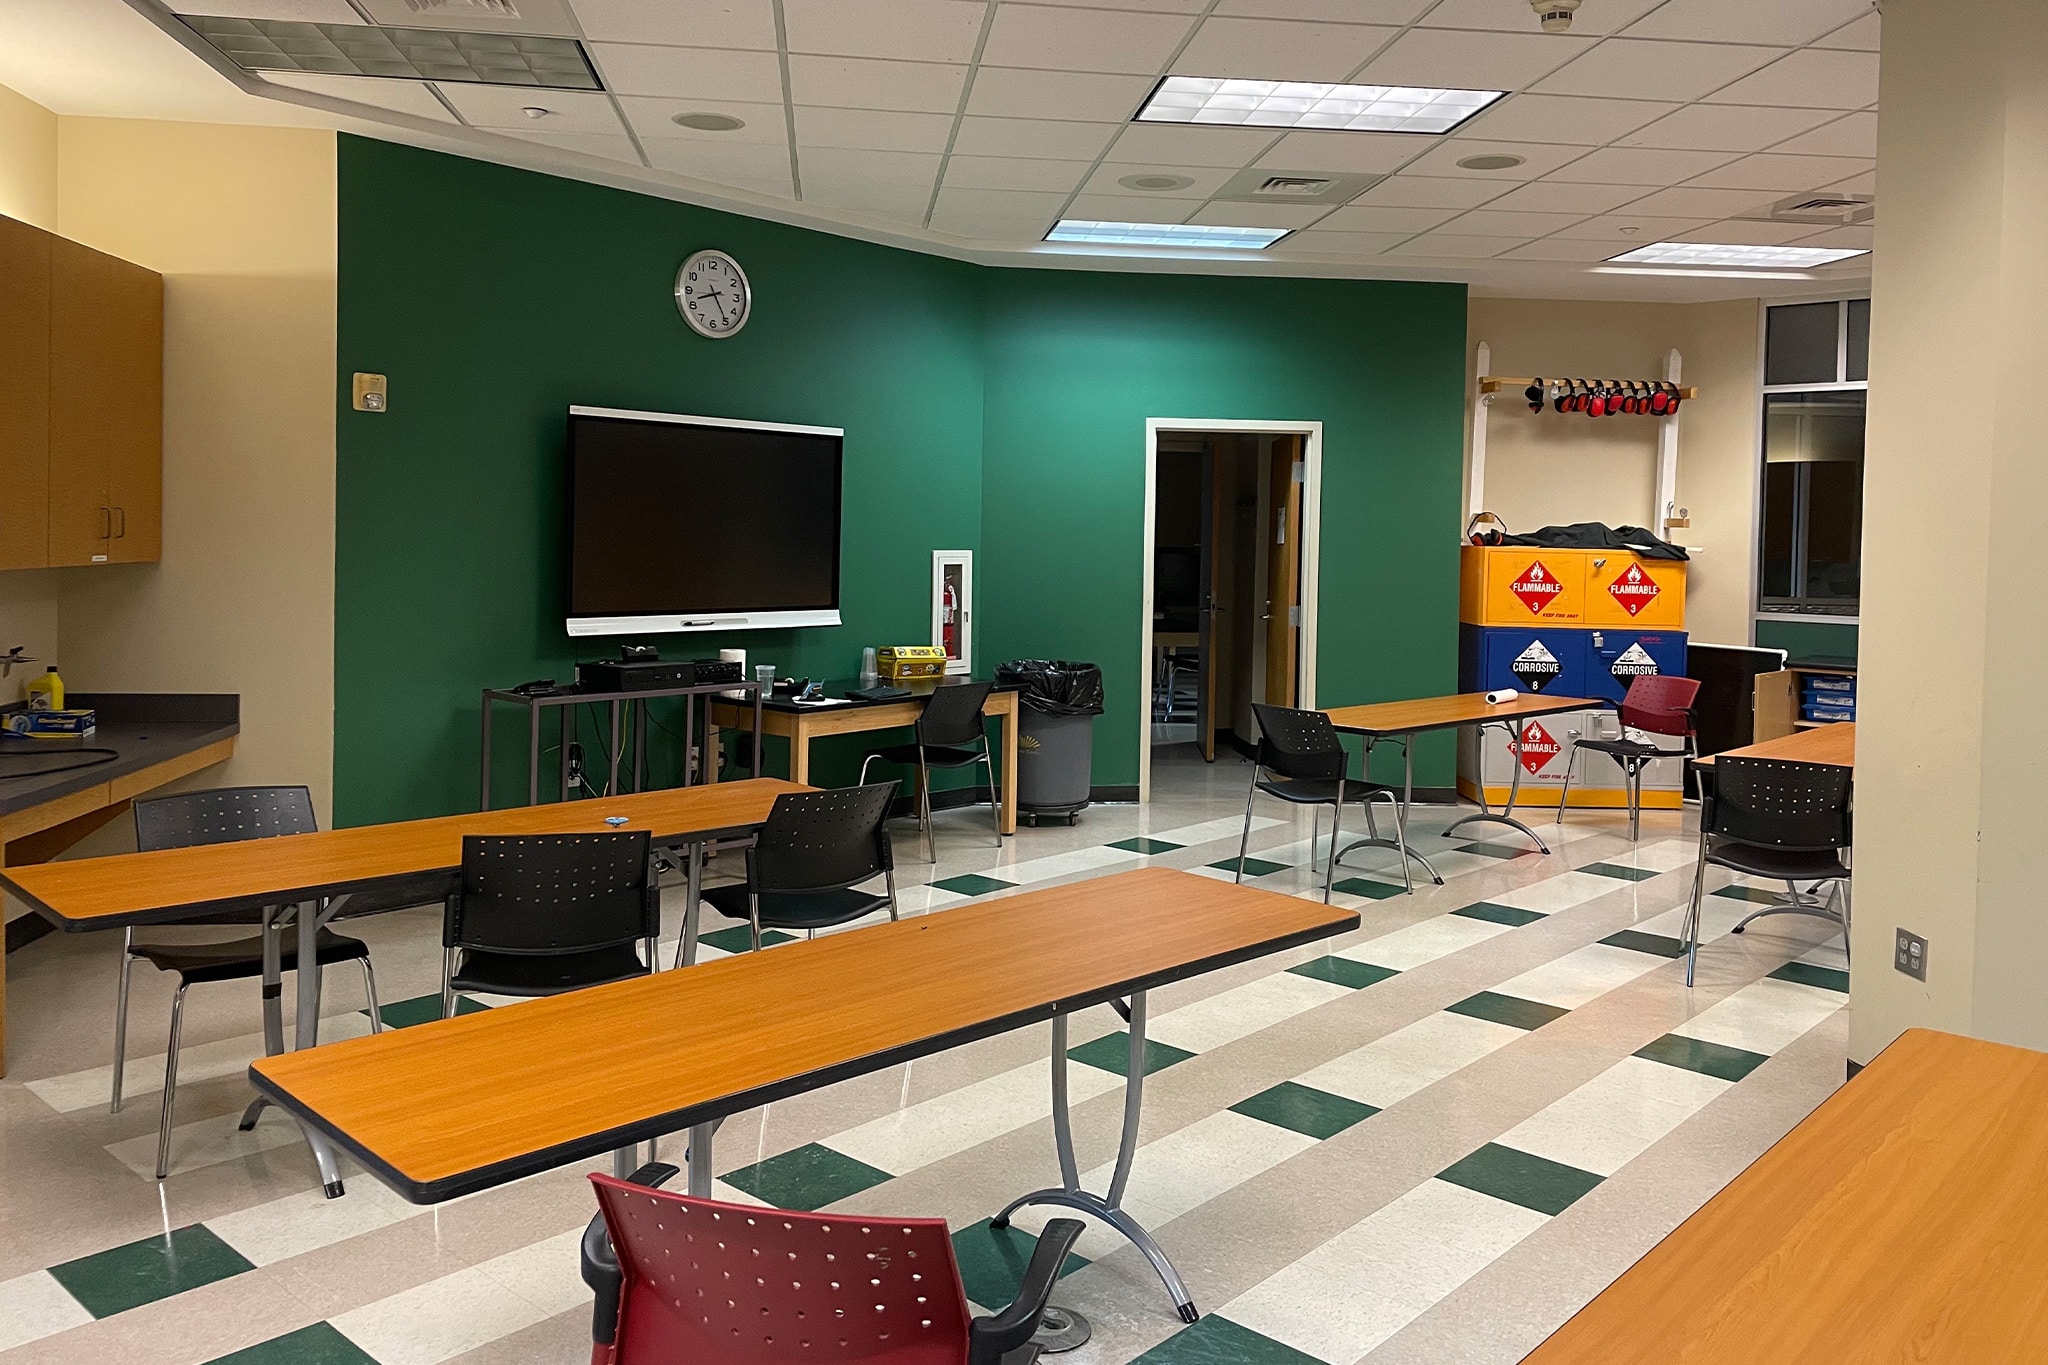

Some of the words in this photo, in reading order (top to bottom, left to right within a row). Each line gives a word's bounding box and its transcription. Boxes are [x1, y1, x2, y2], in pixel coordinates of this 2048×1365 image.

[698, 262, 705, 272] 11
[709, 260, 718, 270] 12
[689, 271, 698, 281] 10
[730, 278, 737, 288] 2
[685, 286, 693, 295] 9
[732, 293, 740, 303] 3
[689, 301, 698, 310] 8
[730, 307, 737, 316] 4
[698, 313, 705, 322] 7
[722, 317, 729, 326] 5
[709, 319, 717, 328] 6
[1513, 582, 1560, 593] FLAMMABLE
[1610, 584, 1658, 595] FLAMMABLE
[1532, 602, 1539, 611] 3
[1630, 604, 1636, 613] 3
[1513, 662, 1559, 673] CORROSIVE
[1611, 665, 1658, 675] CORROSIVE
[1532, 681, 1538, 690] 8
[1511, 742, 1558, 753] FAMMABLE
[1530, 762, 1537, 771] 3
[1629, 763, 1635, 773] 8
